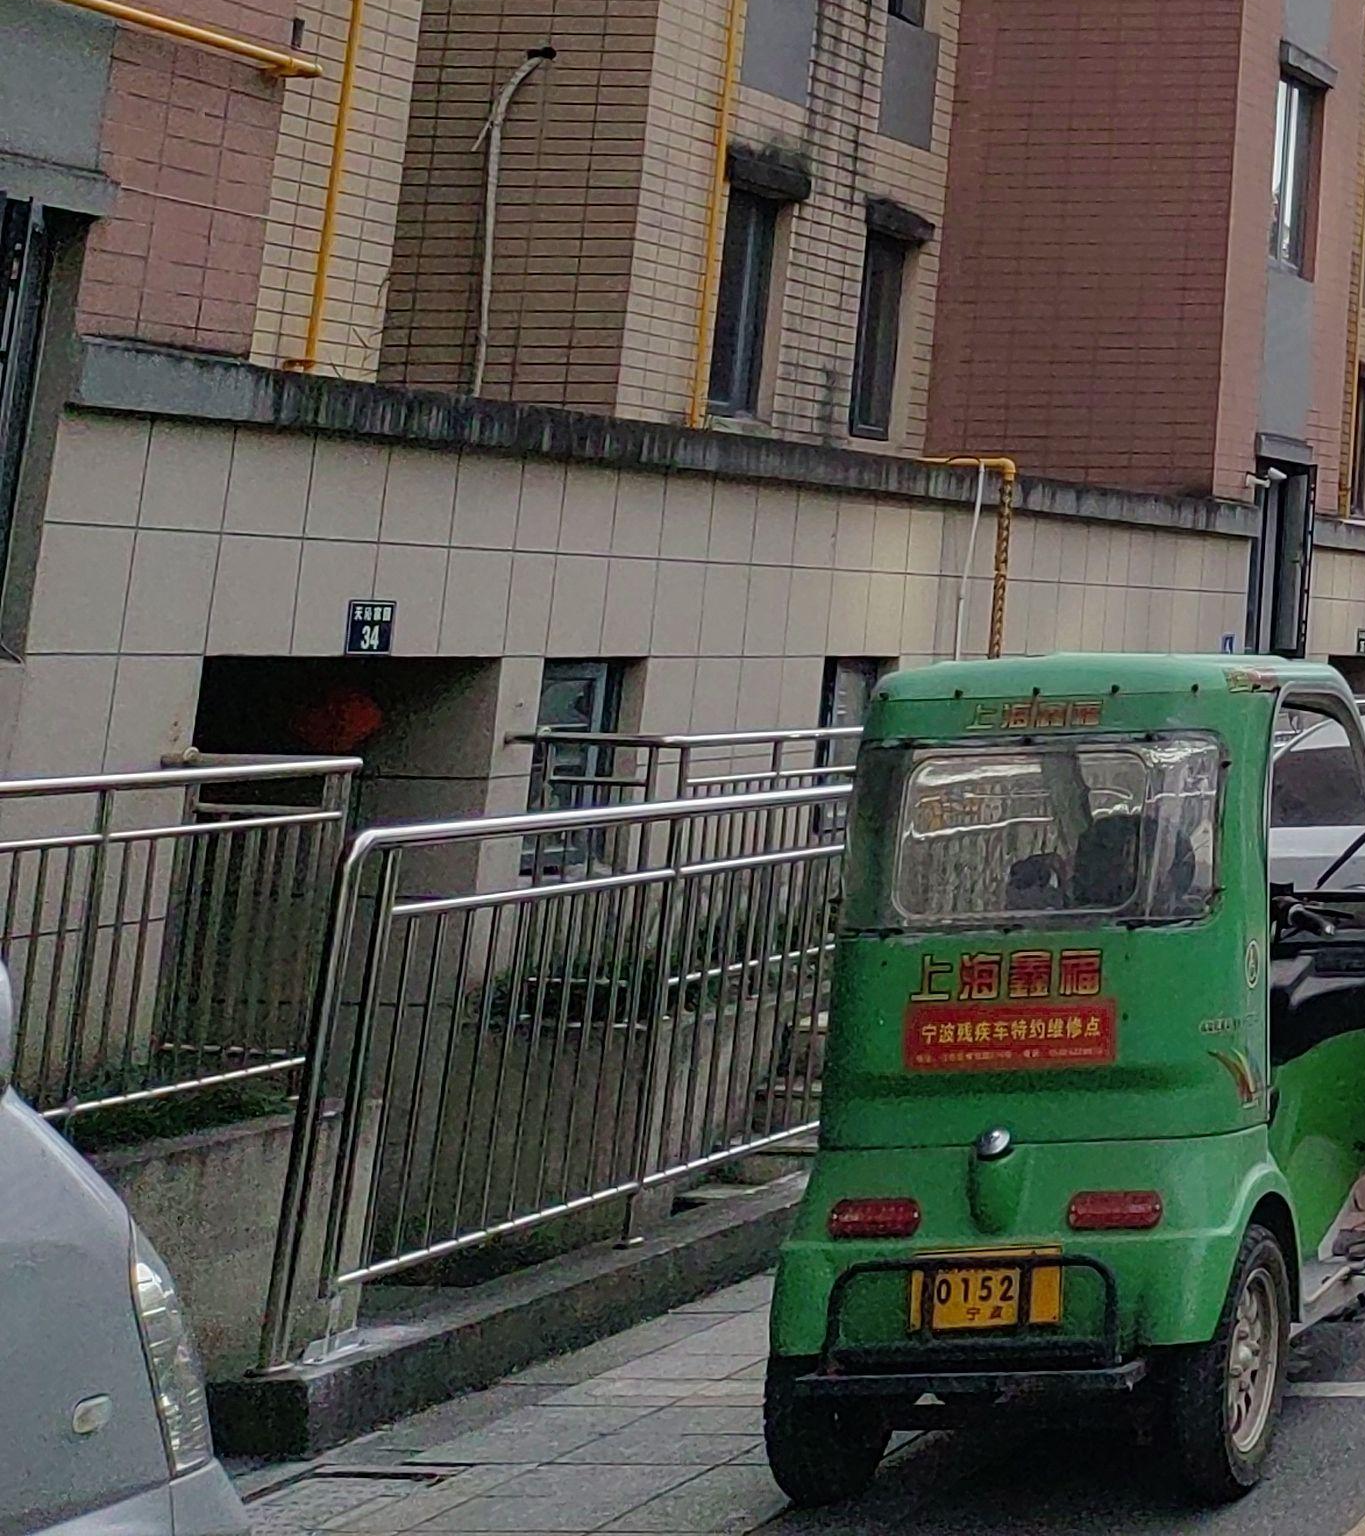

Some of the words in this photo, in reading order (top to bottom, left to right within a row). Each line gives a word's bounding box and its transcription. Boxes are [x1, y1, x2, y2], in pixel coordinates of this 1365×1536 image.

[360, 625, 380, 650] 34
[910, 949, 1102, 1002] 上海鑫福
[921, 1016, 1101, 1045] 宁波残疾车特约维修点
[936, 1275, 1014, 1304] 0152
